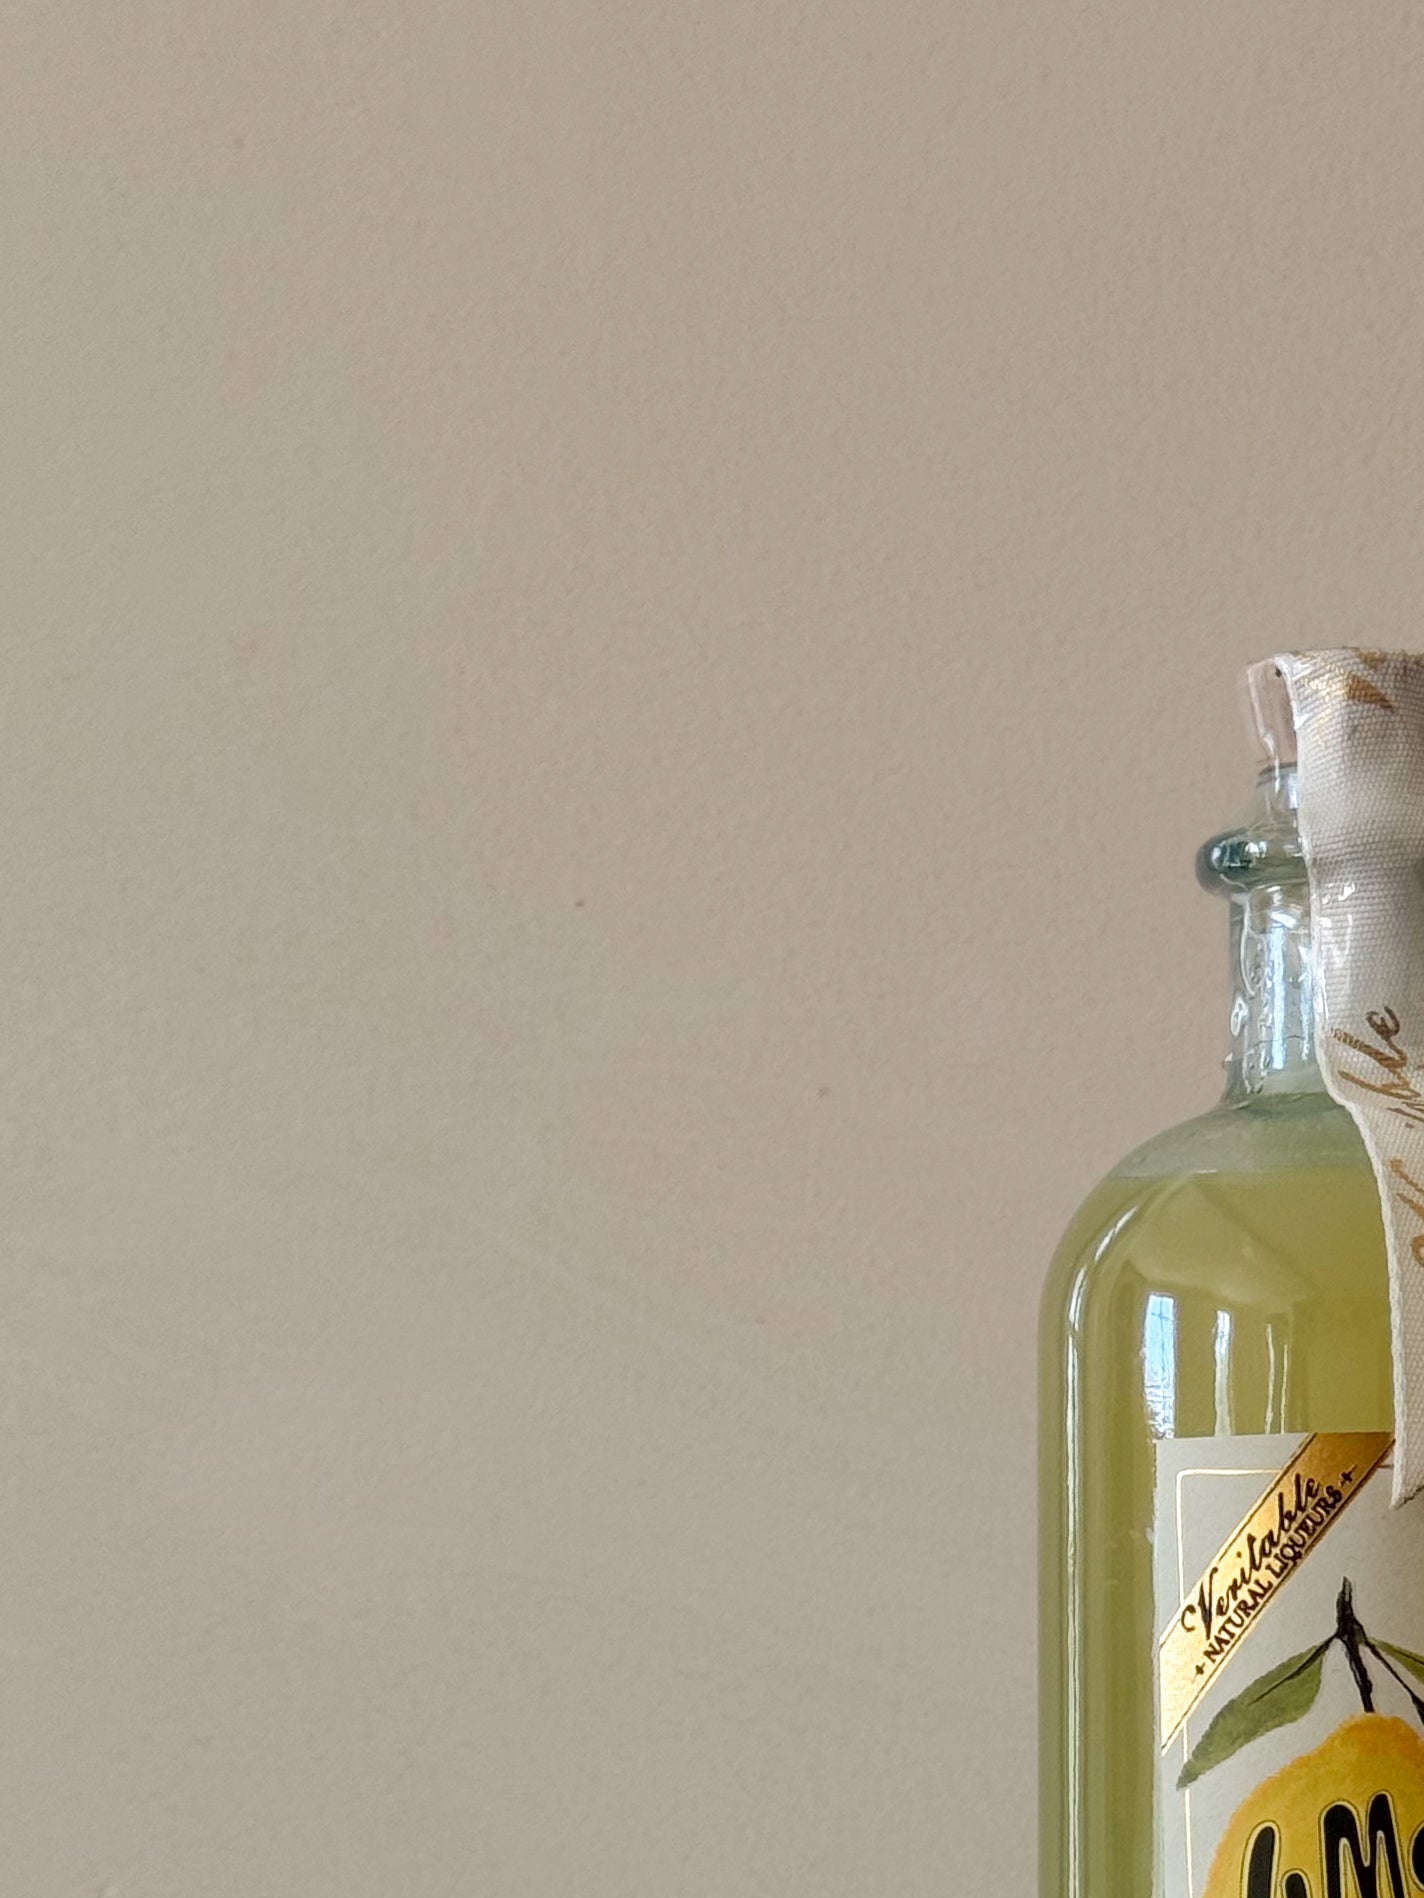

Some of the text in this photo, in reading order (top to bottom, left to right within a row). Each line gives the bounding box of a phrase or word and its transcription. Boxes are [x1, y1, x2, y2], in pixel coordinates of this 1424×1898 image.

[1180, 1473, 1320, 1640] Veritable
[1203, 1484, 1342, 1664] NATURAL LIQUEURS
